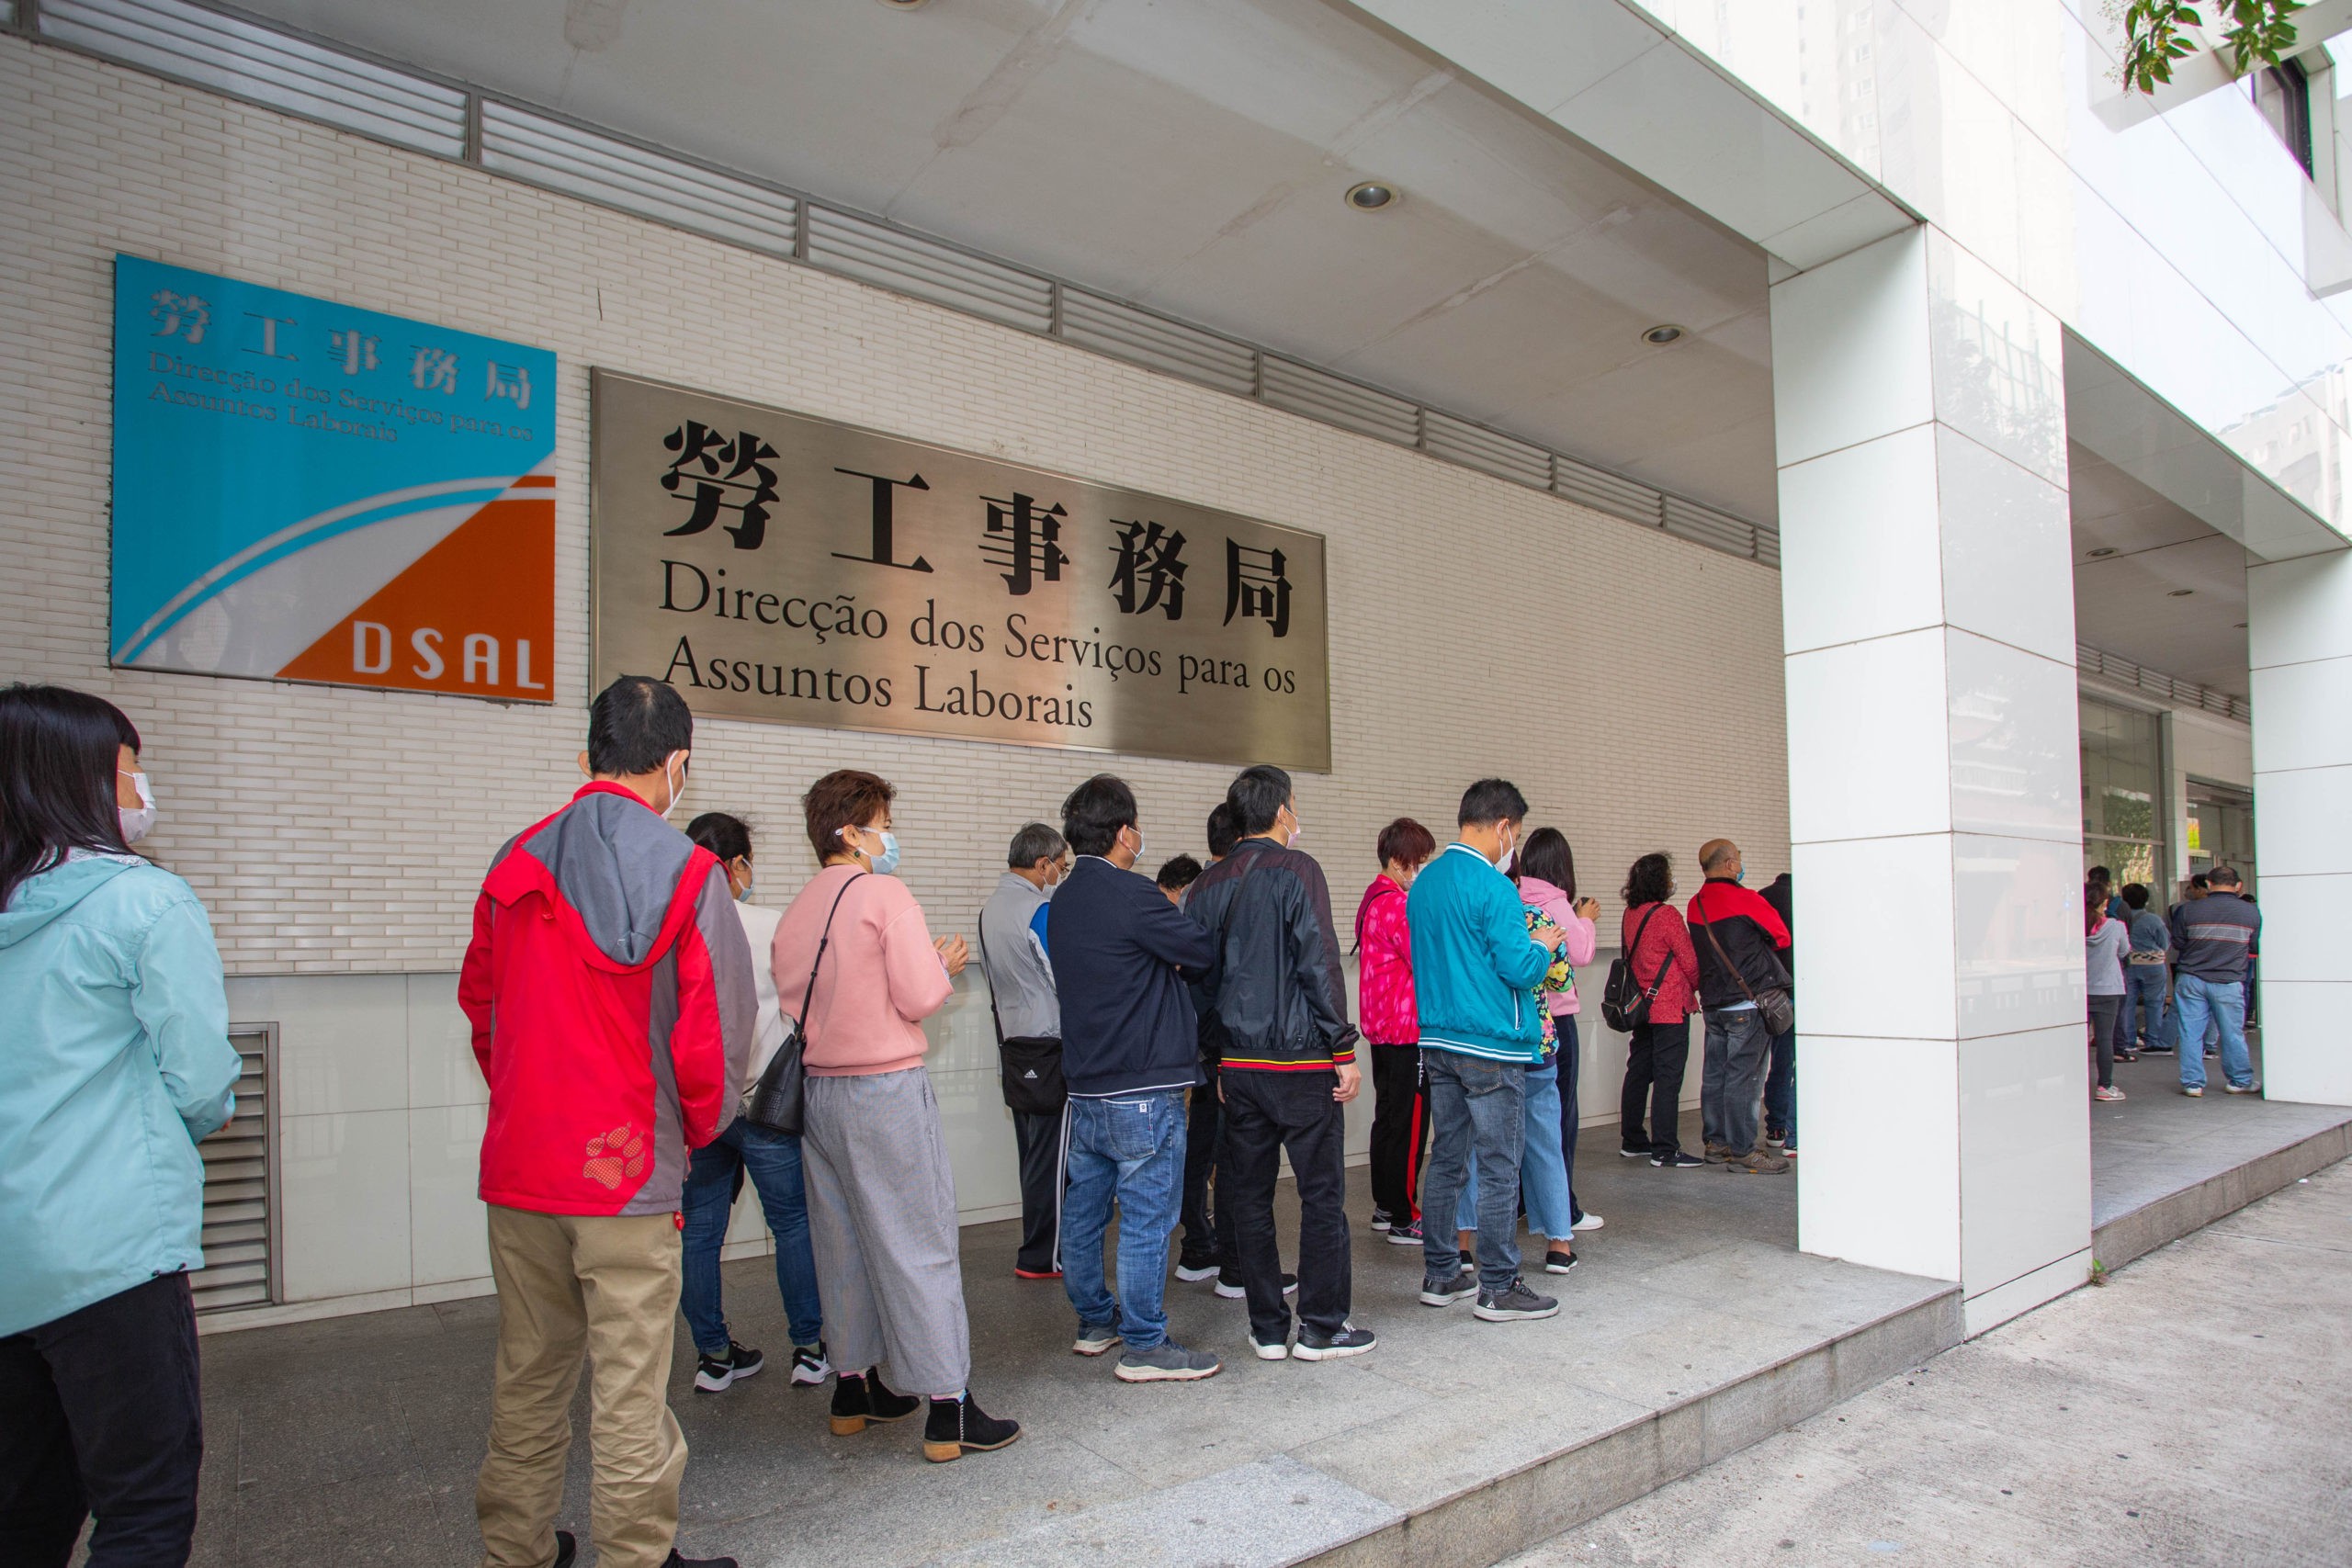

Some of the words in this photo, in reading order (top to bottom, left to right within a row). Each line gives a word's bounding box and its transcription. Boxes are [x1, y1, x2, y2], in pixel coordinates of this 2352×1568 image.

[148, 350, 277, 394] Direcção
[284, 378, 332, 404] dos
[338, 389, 443, 425] Serviços
[449, 414, 503, 436] para
[508, 425, 533, 442] os
[149, 288, 532, 411] 勞工事務局
[148, 381, 277, 422] Assuntos
[287, 404, 398, 442] Laborais
[660, 419, 1293, 638] 勞工事務局
[353, 620, 546, 690] DSAL
[658, 558, 888, 646] Direcção
[910, 598, 985, 653] dos
[1004, 613, 1162, 682] Serviços
[1177, 652, 1250, 694] para
[1263, 666, 1295, 694] os
[662, 635, 892, 708] Assuntos
[913, 664, 1093, 728] Laborais
